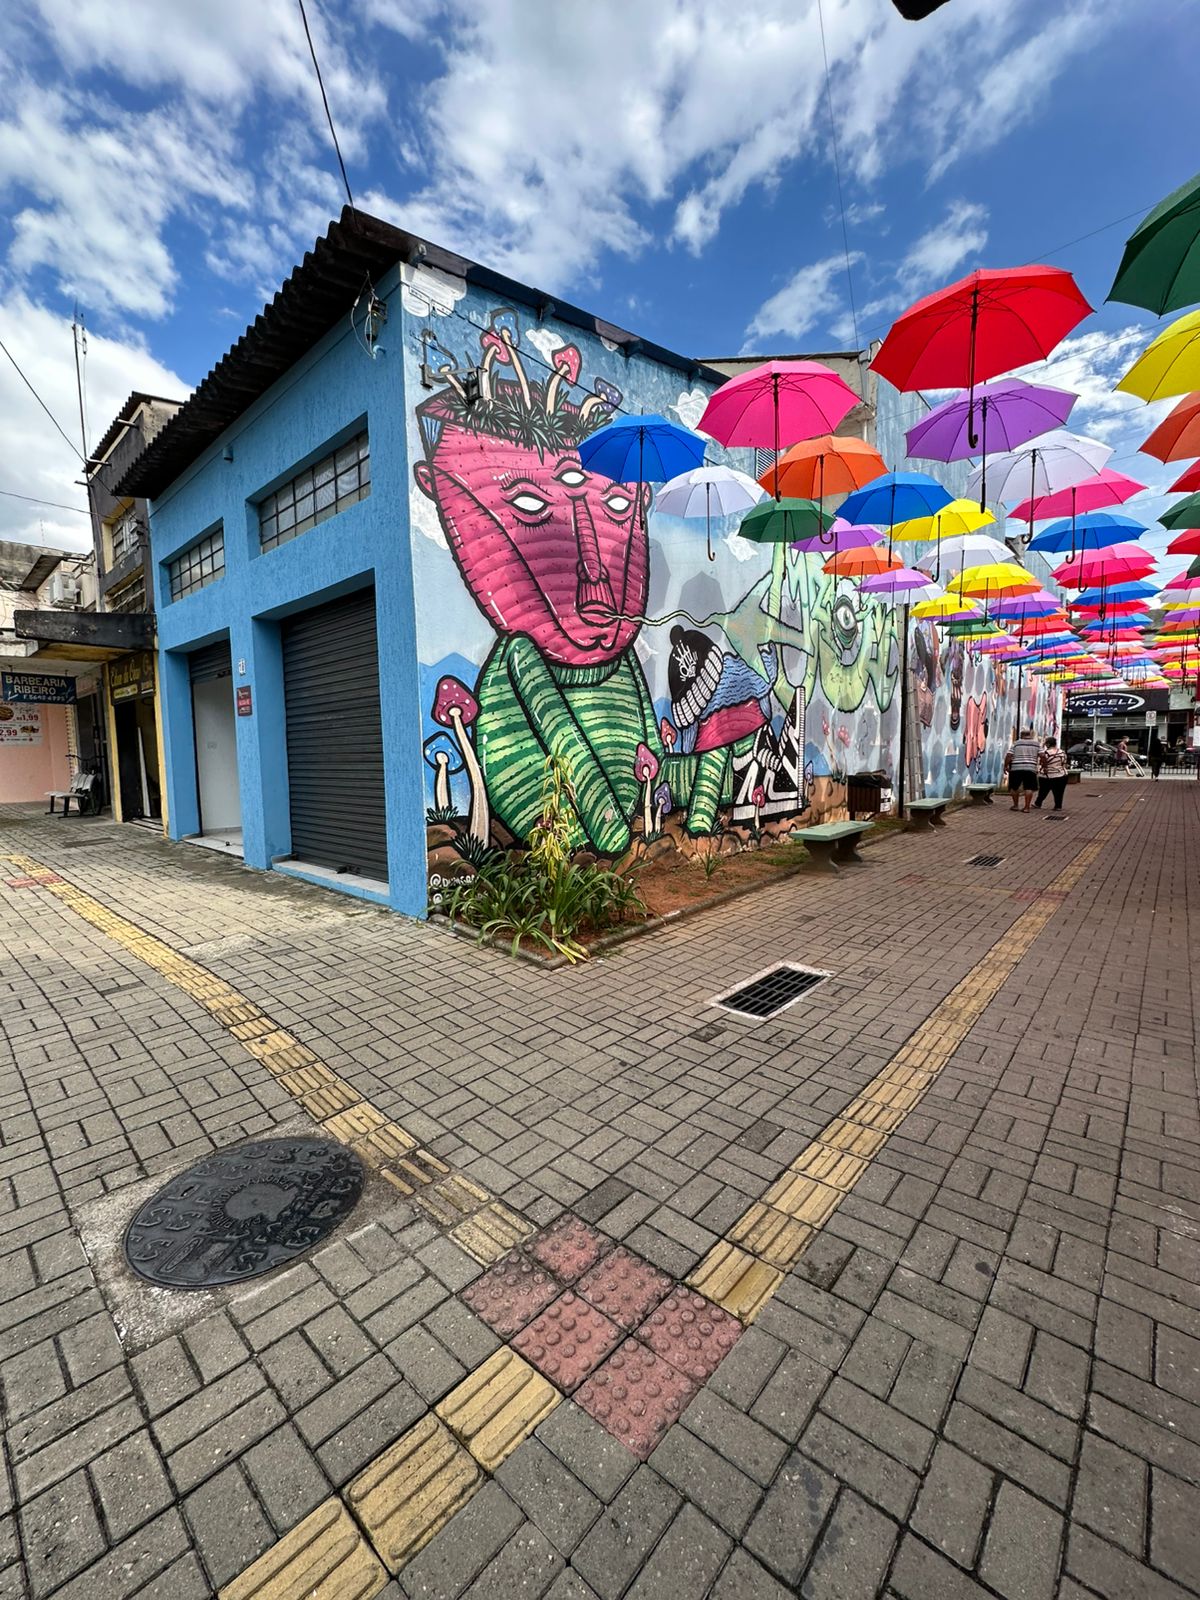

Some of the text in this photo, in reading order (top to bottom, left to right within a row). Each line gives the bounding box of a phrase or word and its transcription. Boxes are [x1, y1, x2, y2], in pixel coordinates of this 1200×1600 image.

[5, 675, 67, 688] BARBEARIA
[13, 685, 56, 695] RIBEIRO
[1066, 698, 1136, 707] PROCELL
